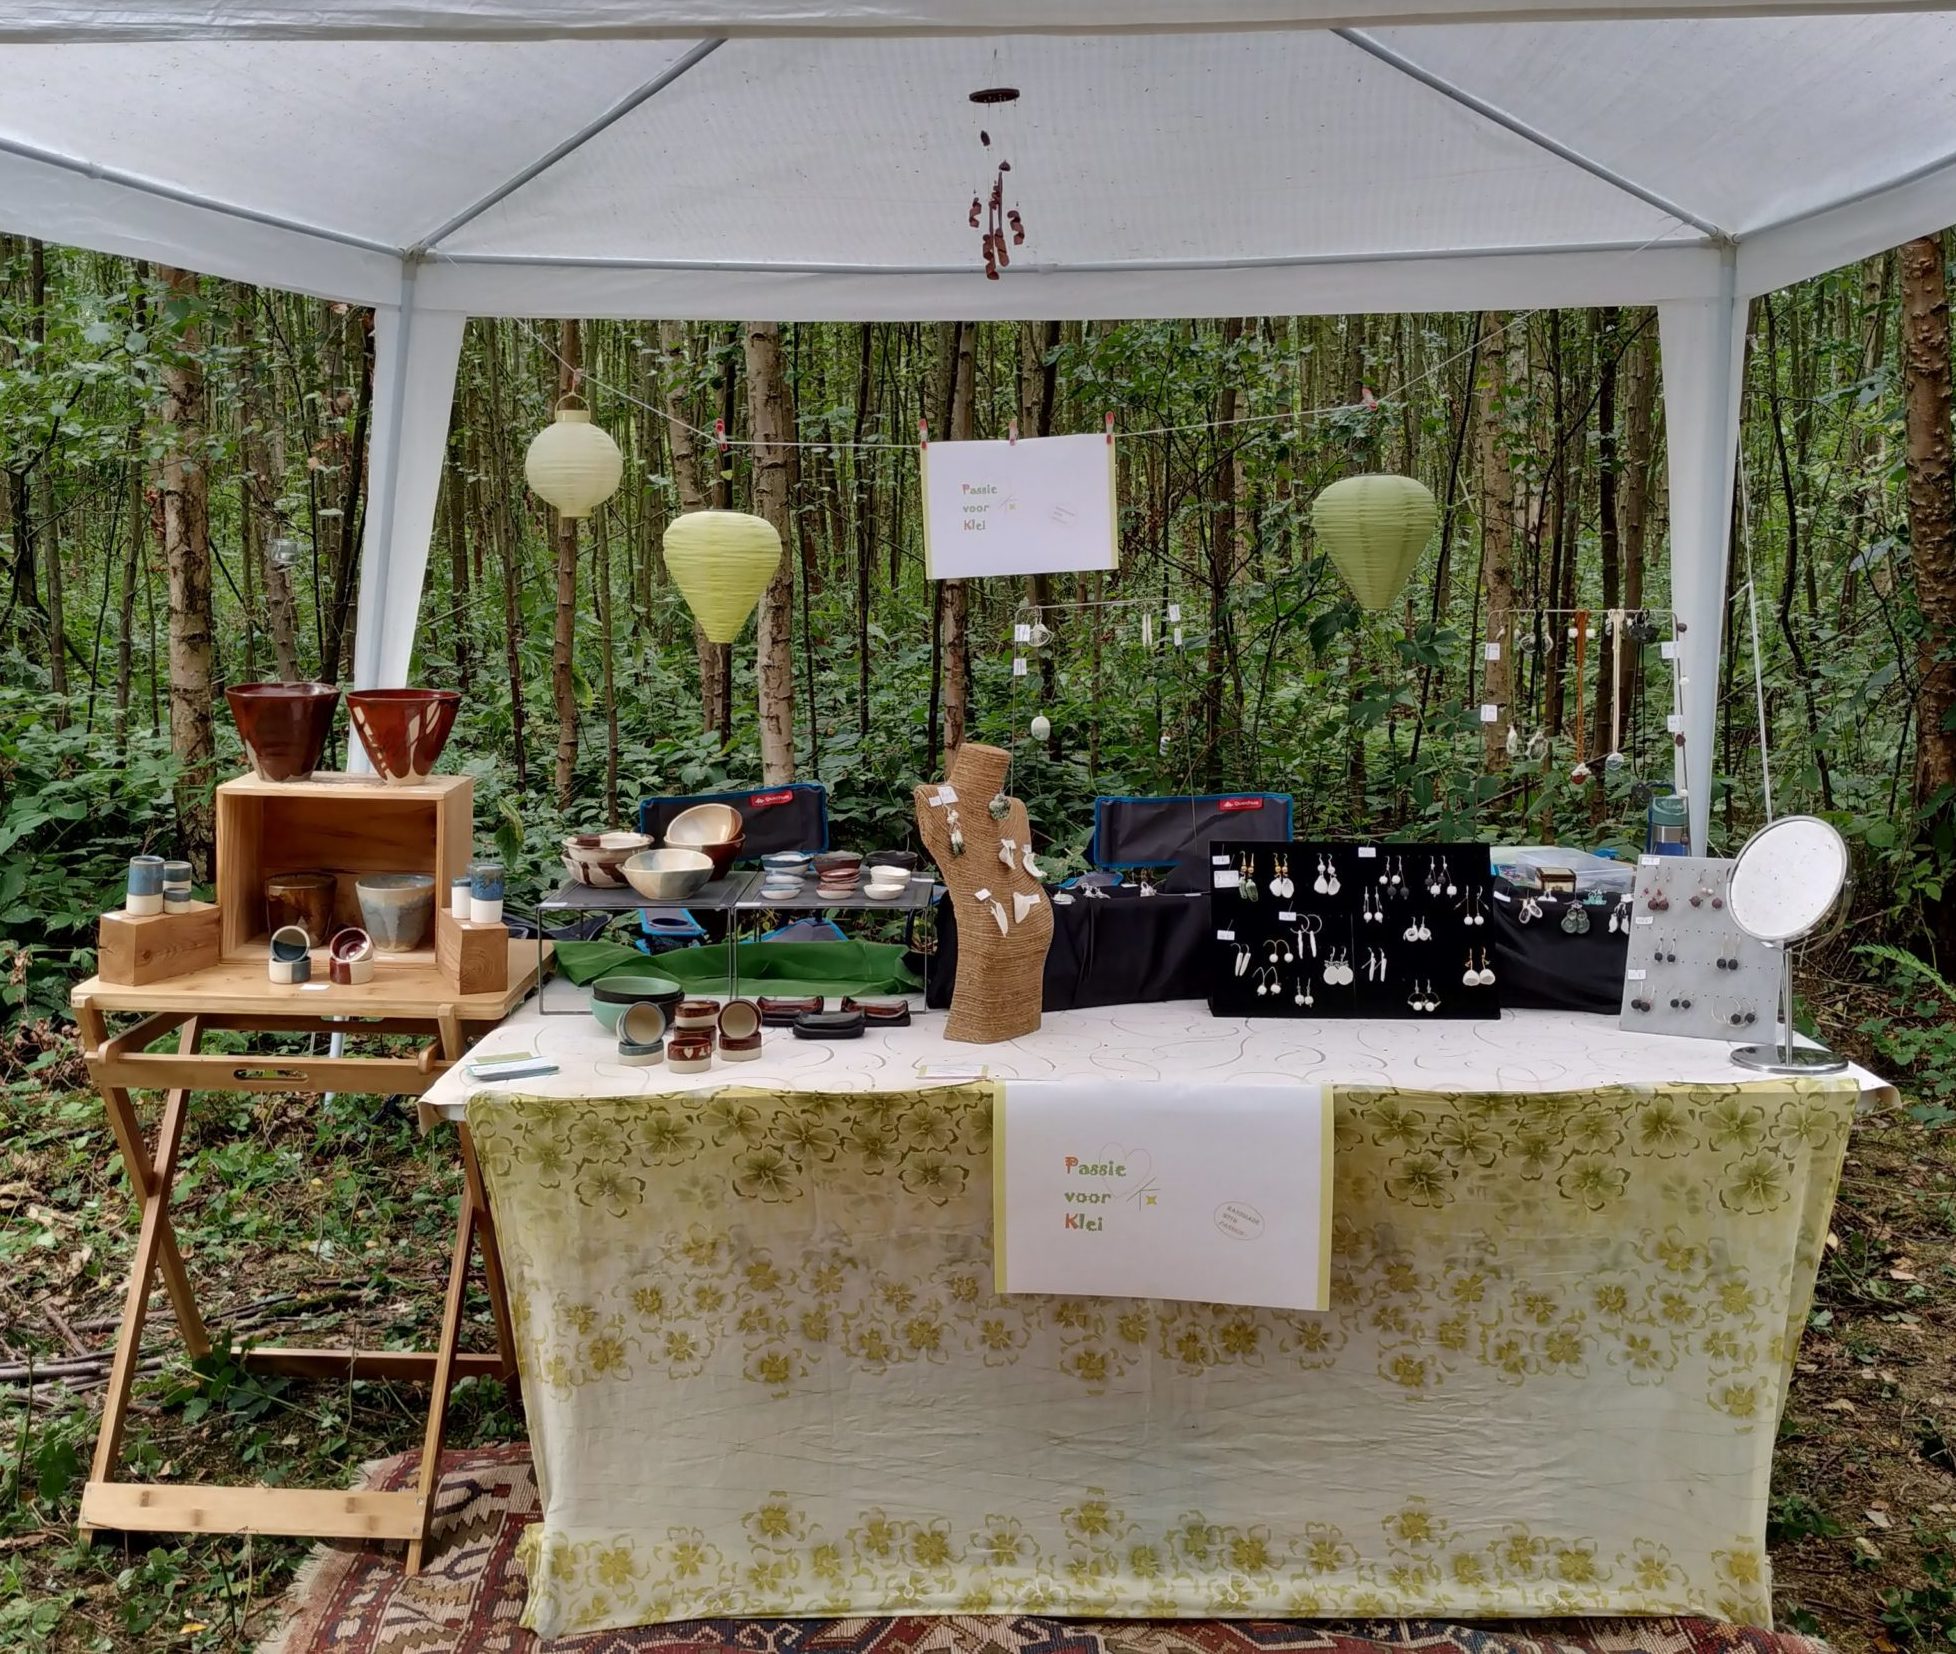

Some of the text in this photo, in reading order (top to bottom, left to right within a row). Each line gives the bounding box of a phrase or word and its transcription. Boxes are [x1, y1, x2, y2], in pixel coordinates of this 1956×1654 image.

[962, 483, 998, 495] Passie
[962, 504, 990, 513] voor
[963, 519, 986, 531] Klei
[1064, 1156, 1127, 1176] Passie
[1064, 1192, 1112, 1204] voor
[1064, 1213, 1103, 1231] Klei
